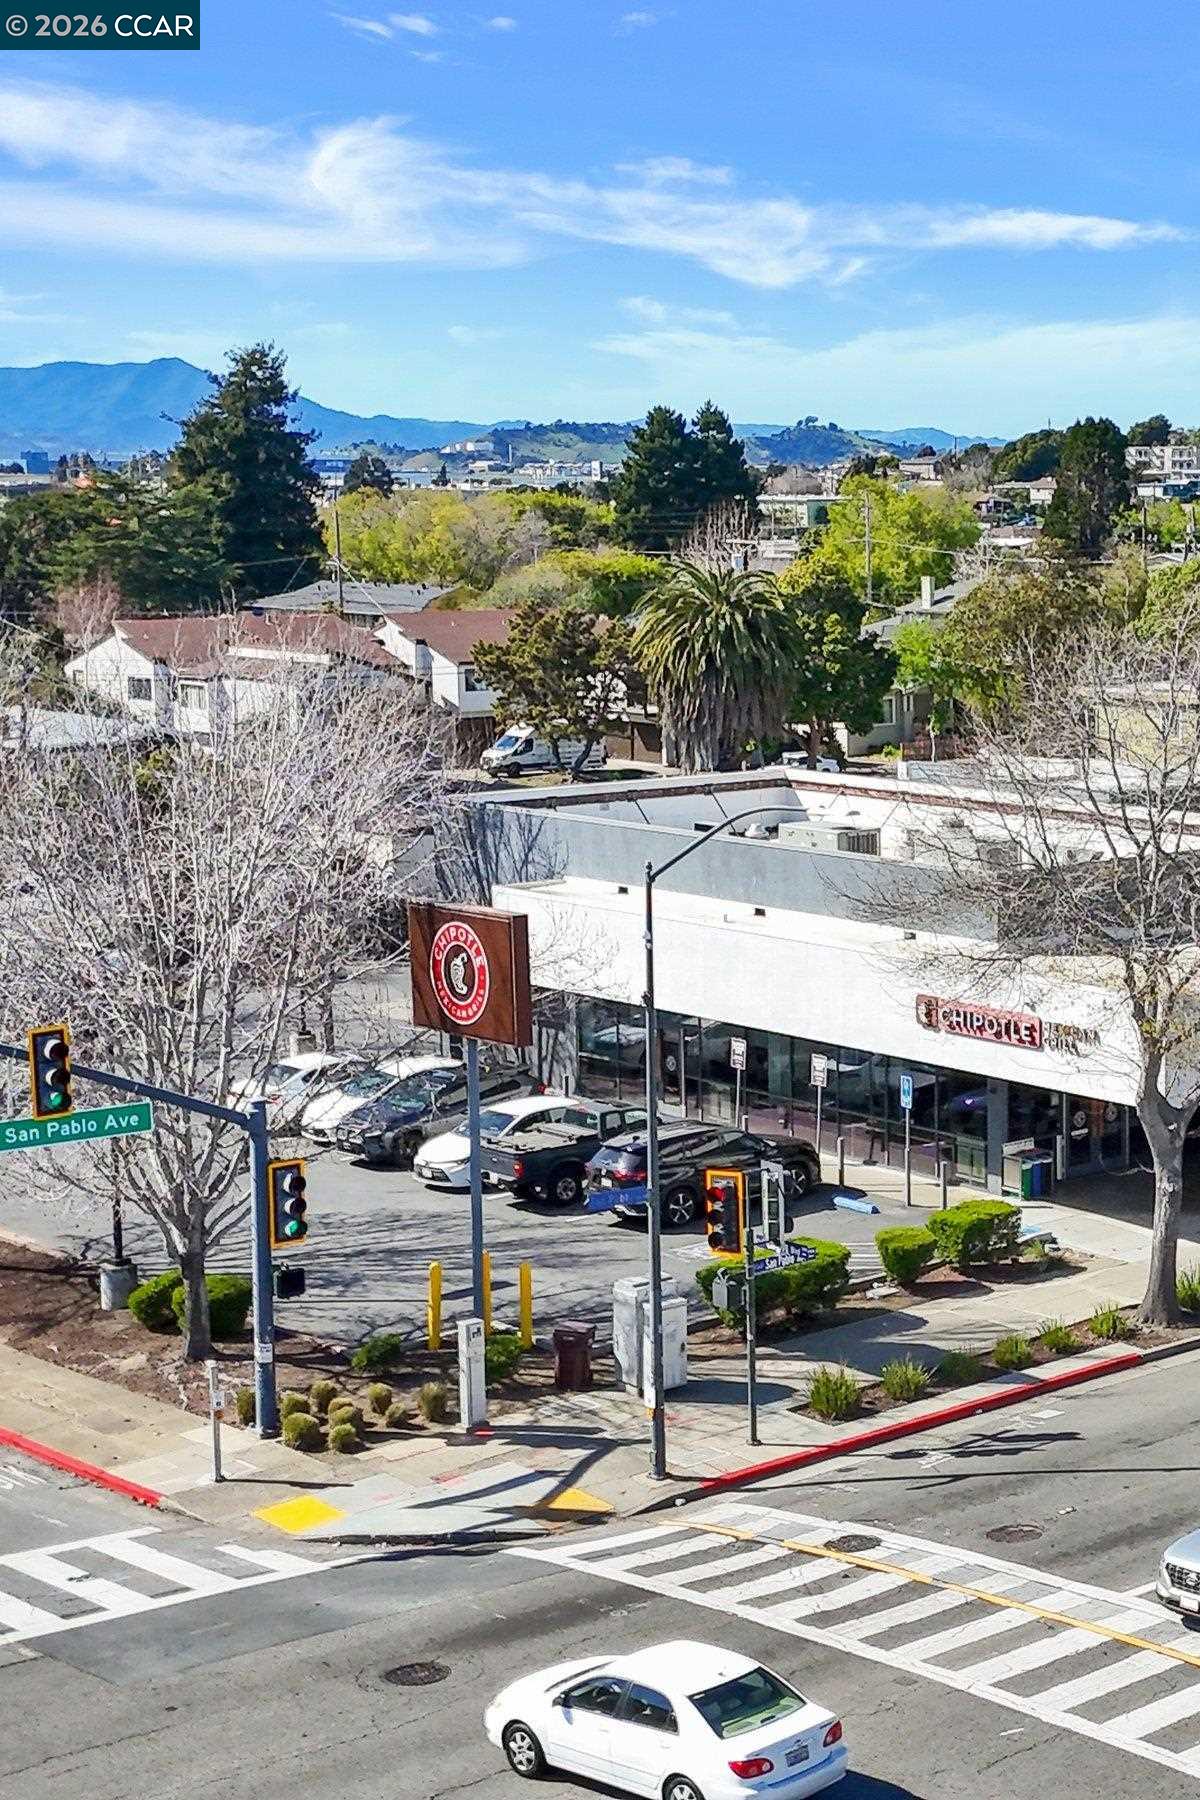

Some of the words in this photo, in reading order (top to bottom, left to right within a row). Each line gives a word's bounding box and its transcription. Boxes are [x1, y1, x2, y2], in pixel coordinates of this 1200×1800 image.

[434, 926, 485, 967] CHIPOTLE
[939, 1007, 1034, 1041] CHIPOTLE
[5, 1127, 40, 1144] San
[47, 1119, 97, 1138] Pablo
[104, 1114, 140, 1130] Ave
